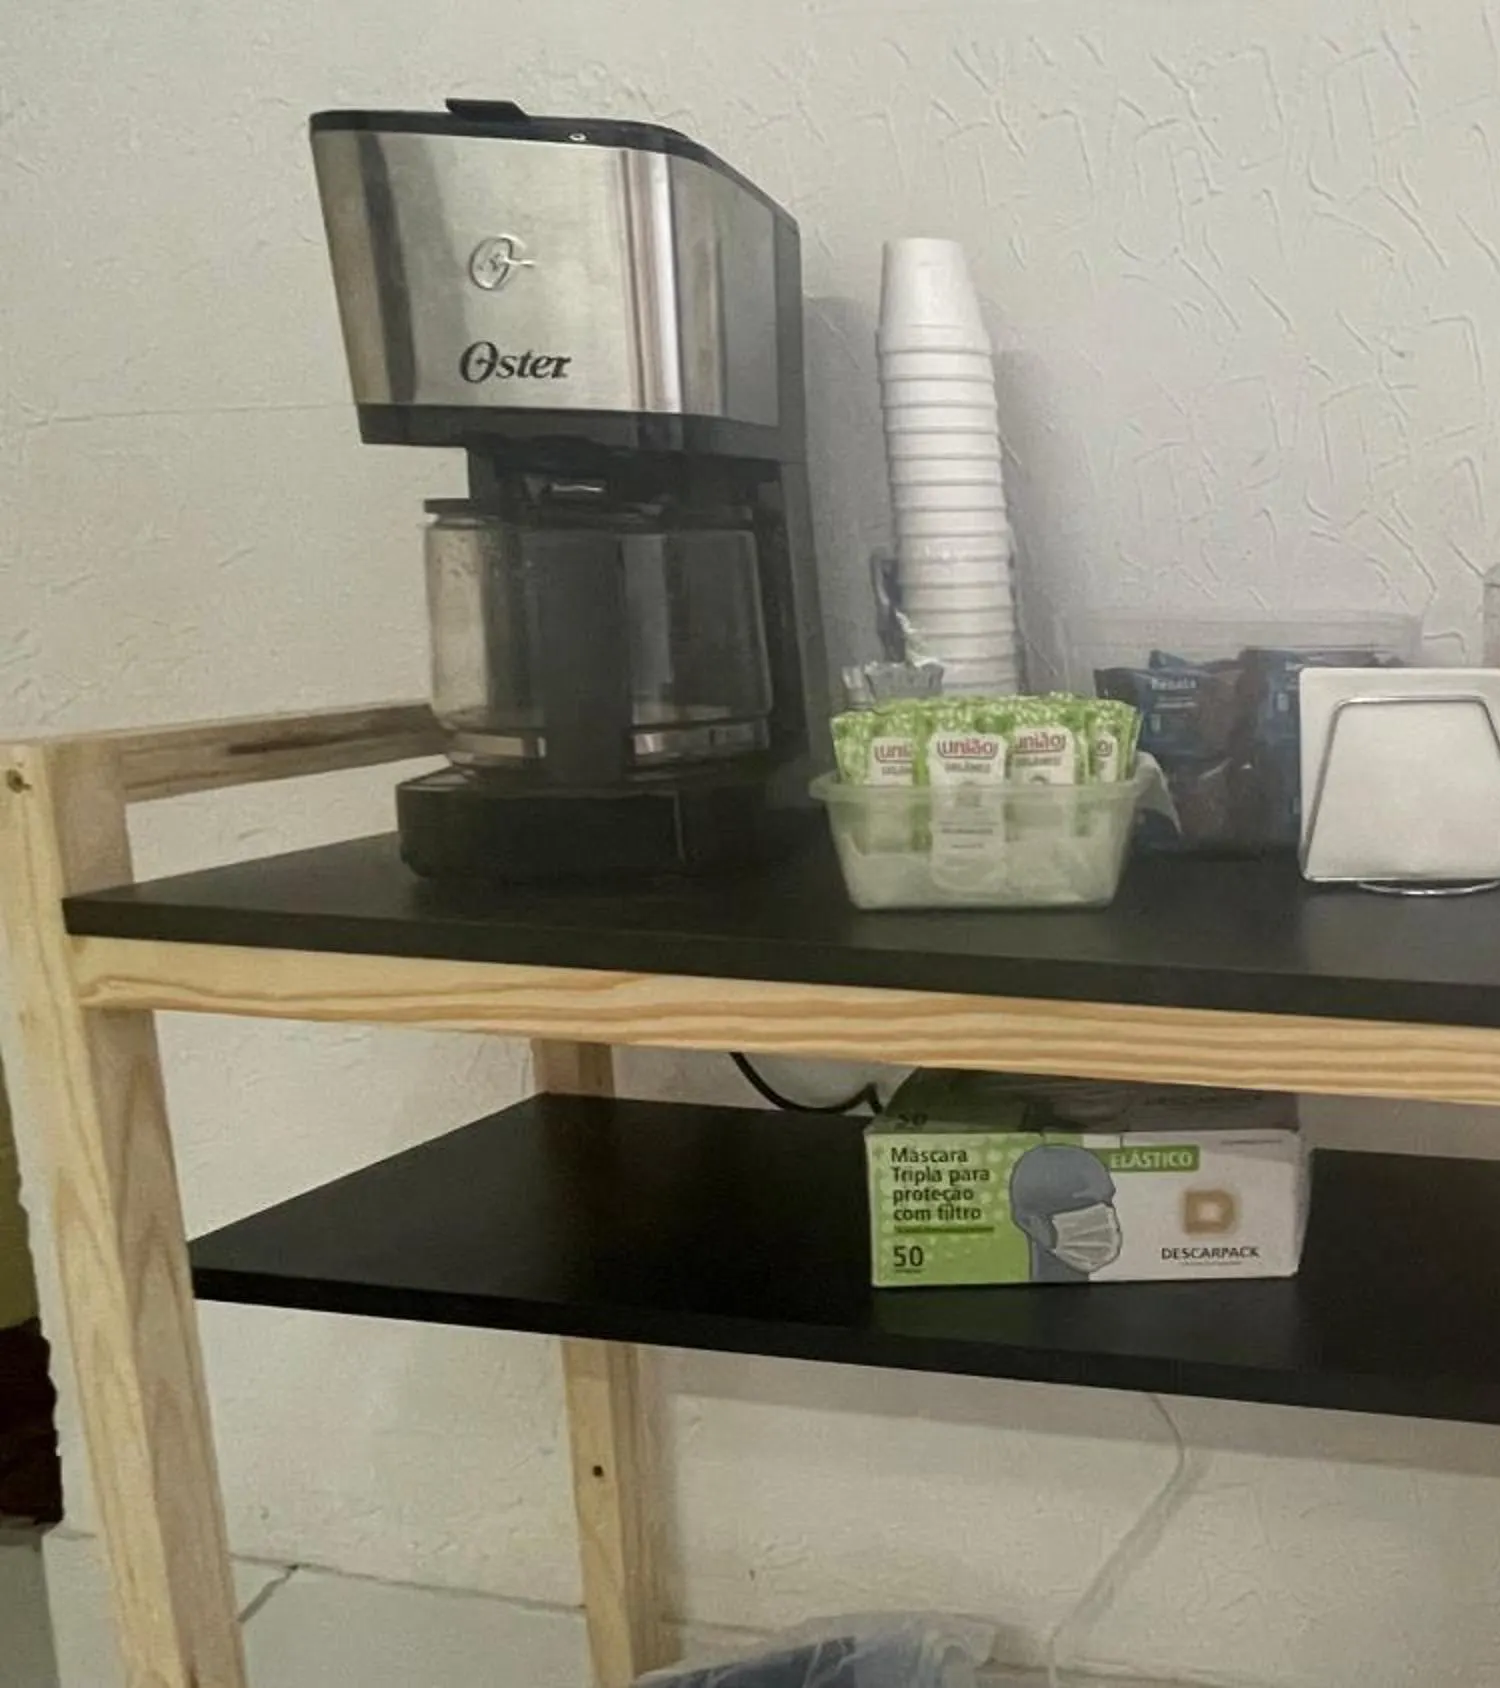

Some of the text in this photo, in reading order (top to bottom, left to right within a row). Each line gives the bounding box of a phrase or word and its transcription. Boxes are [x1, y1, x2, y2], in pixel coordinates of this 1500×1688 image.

[460, 341, 572, 384] Oster
[1110, 1149, 1194, 1169] ELÁSTICO
[892, 1165, 991, 1186] Tripla para
[893, 1203, 982, 1222] com filtro
[893, 1245, 924, 1268] 50
[1161, 1246, 1260, 1261] DESCARPACK
